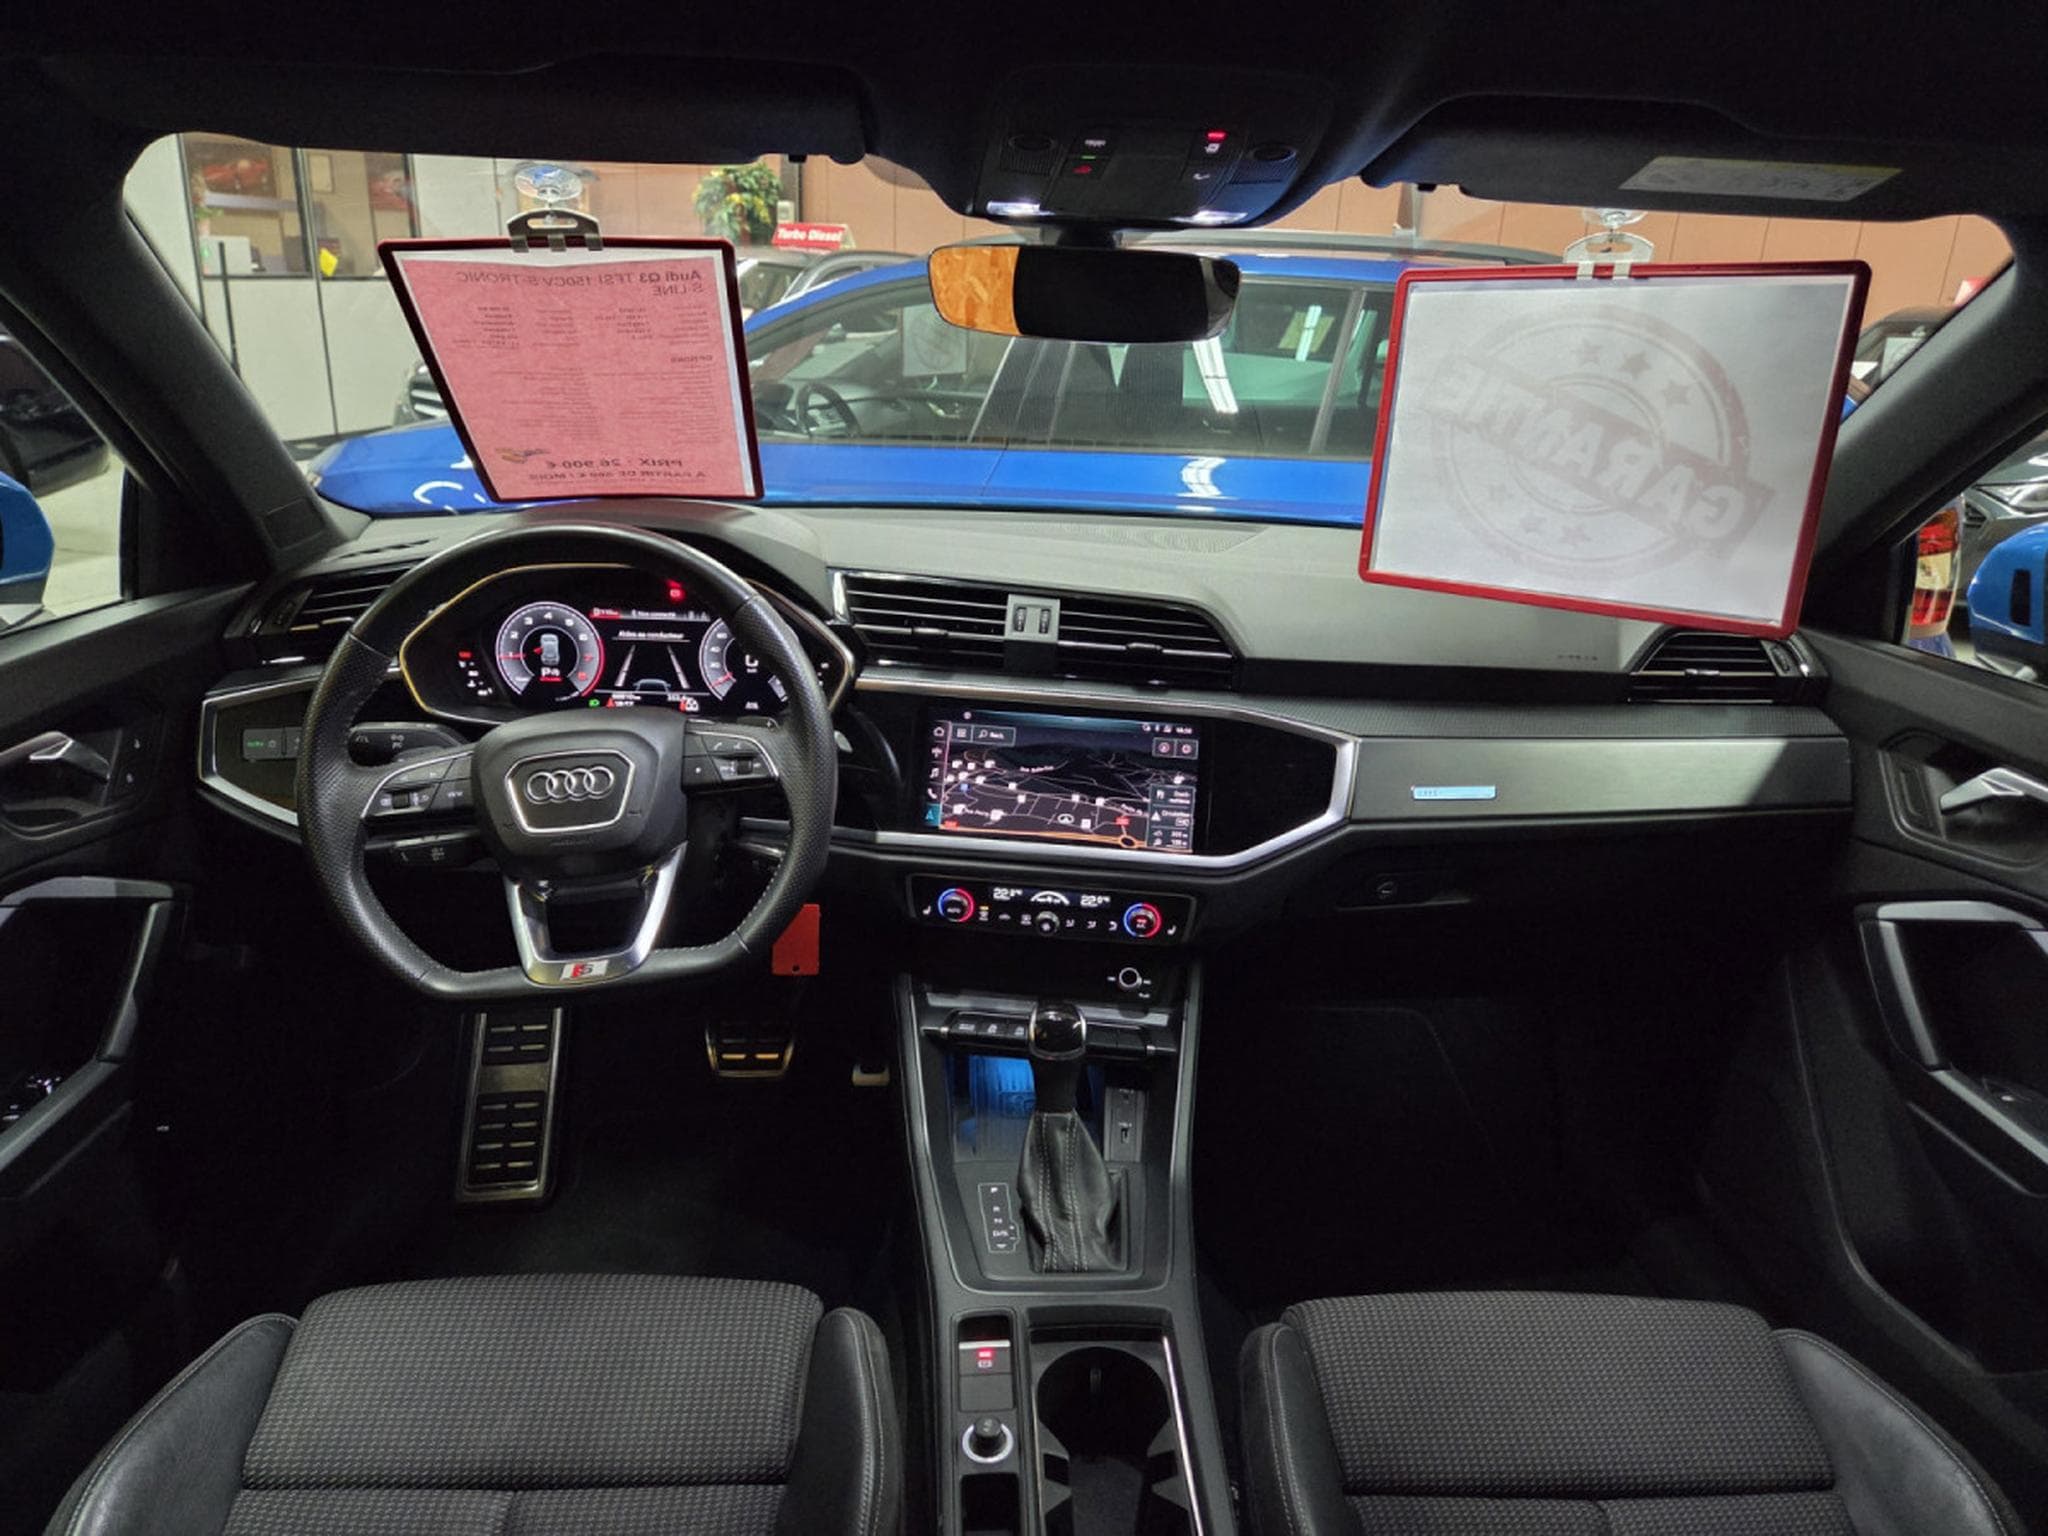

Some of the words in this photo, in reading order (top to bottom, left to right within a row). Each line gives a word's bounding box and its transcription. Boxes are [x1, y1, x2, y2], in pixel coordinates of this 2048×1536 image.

[777, 228, 807, 240] Turbo
[807, 229, 843, 242] Diesel
[544, 611, 553, 620] 4
